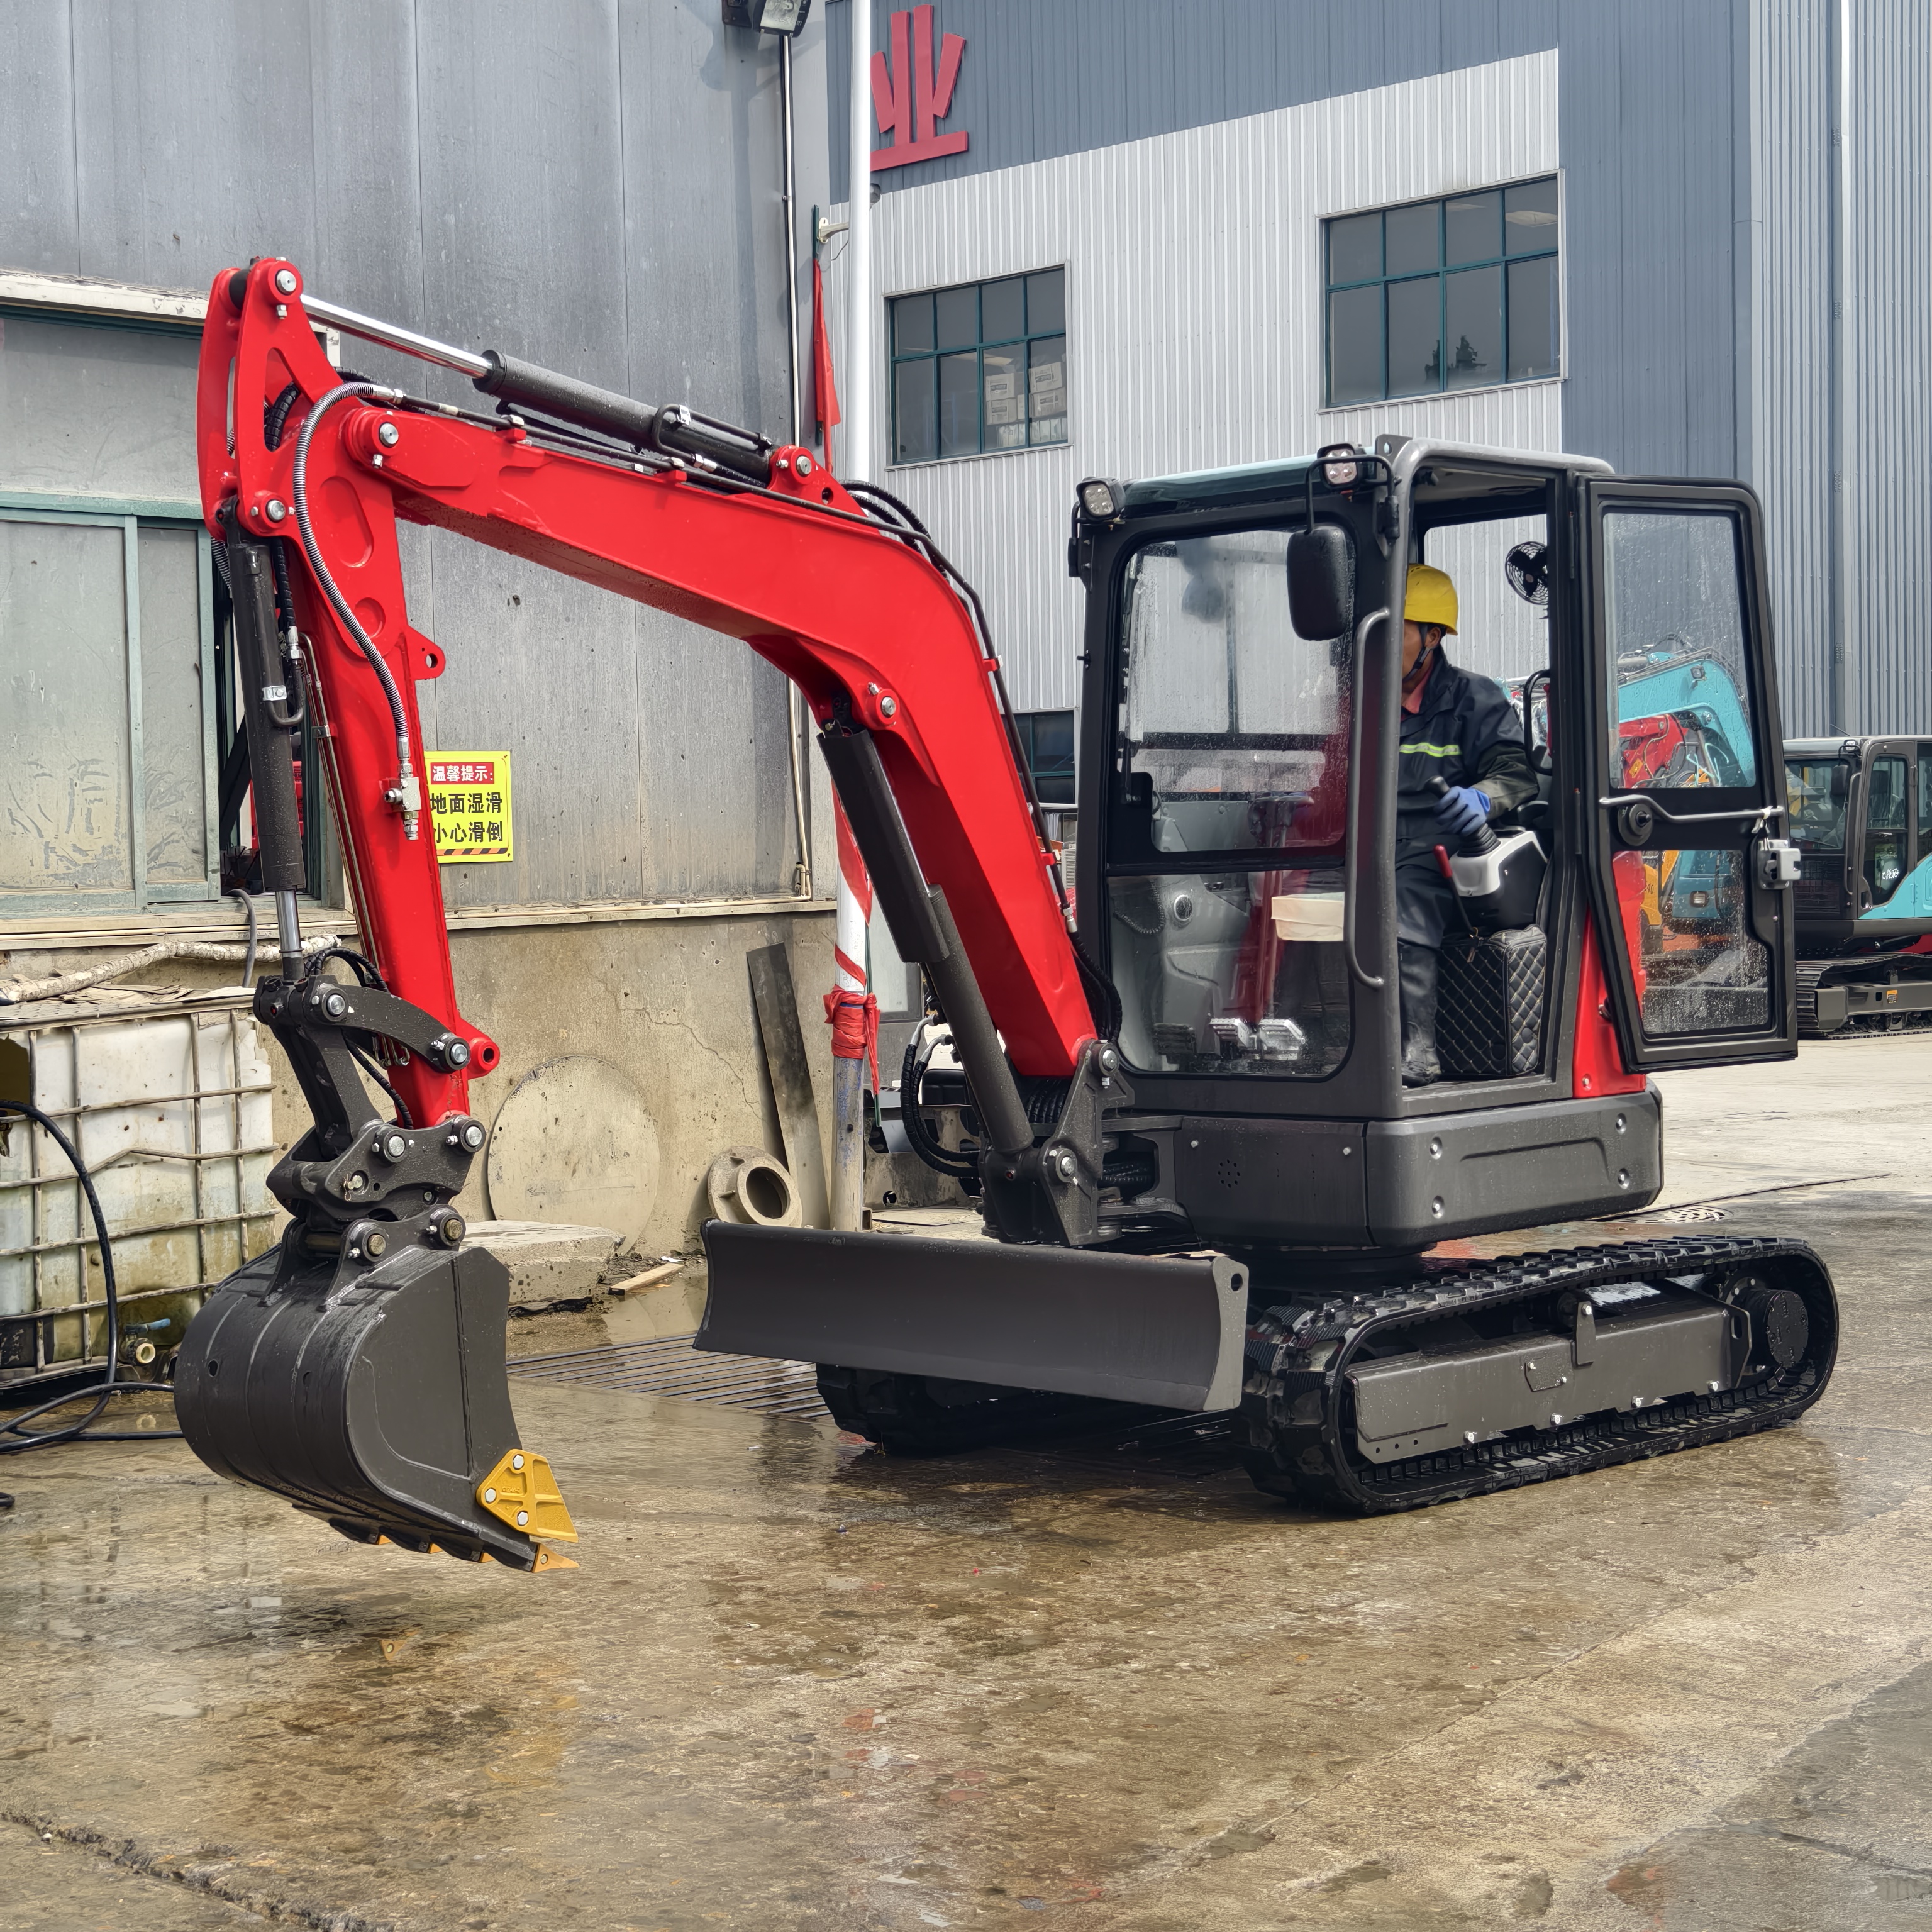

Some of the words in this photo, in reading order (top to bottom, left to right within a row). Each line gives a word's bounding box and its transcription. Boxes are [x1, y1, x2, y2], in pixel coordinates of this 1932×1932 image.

[870, 4, 969, 171] 业
[430, 792, 502, 814] 地面湿滑
[434, 821, 503, 844] 小心滑倒
